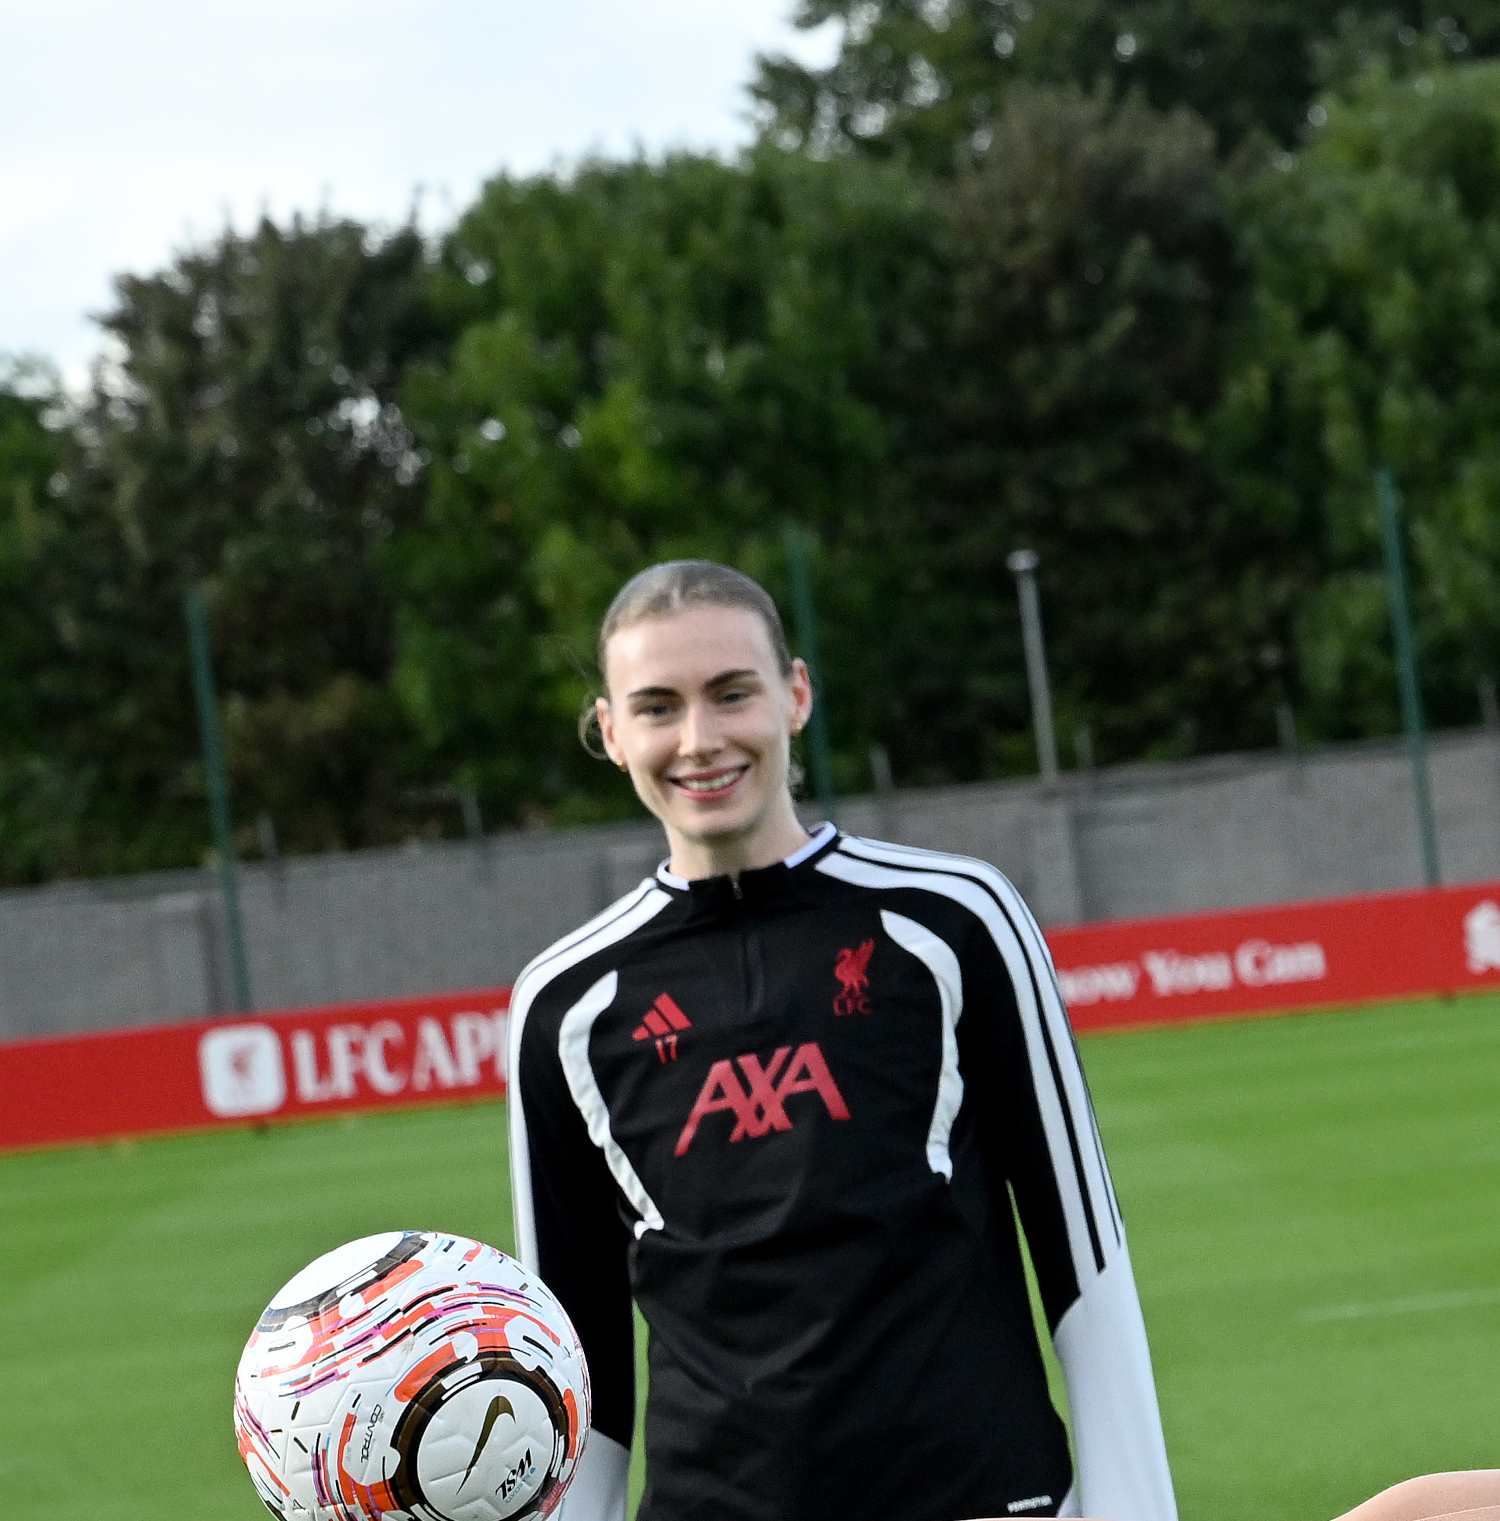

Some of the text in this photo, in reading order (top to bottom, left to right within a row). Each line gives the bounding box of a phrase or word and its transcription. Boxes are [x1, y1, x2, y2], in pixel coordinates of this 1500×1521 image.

[1141, 948, 1233, 997] You
[1235, 938, 1327, 987] Can
[833, 994, 874, 1016] LFC
[292, 1020, 406, 1103] LFC
[655, 1034, 678, 1064] 17
[674, 1042, 850, 1157] AXA
[361, 1404, 382, 1463] CONTROL
[495, 1447, 532, 1500] WSL
